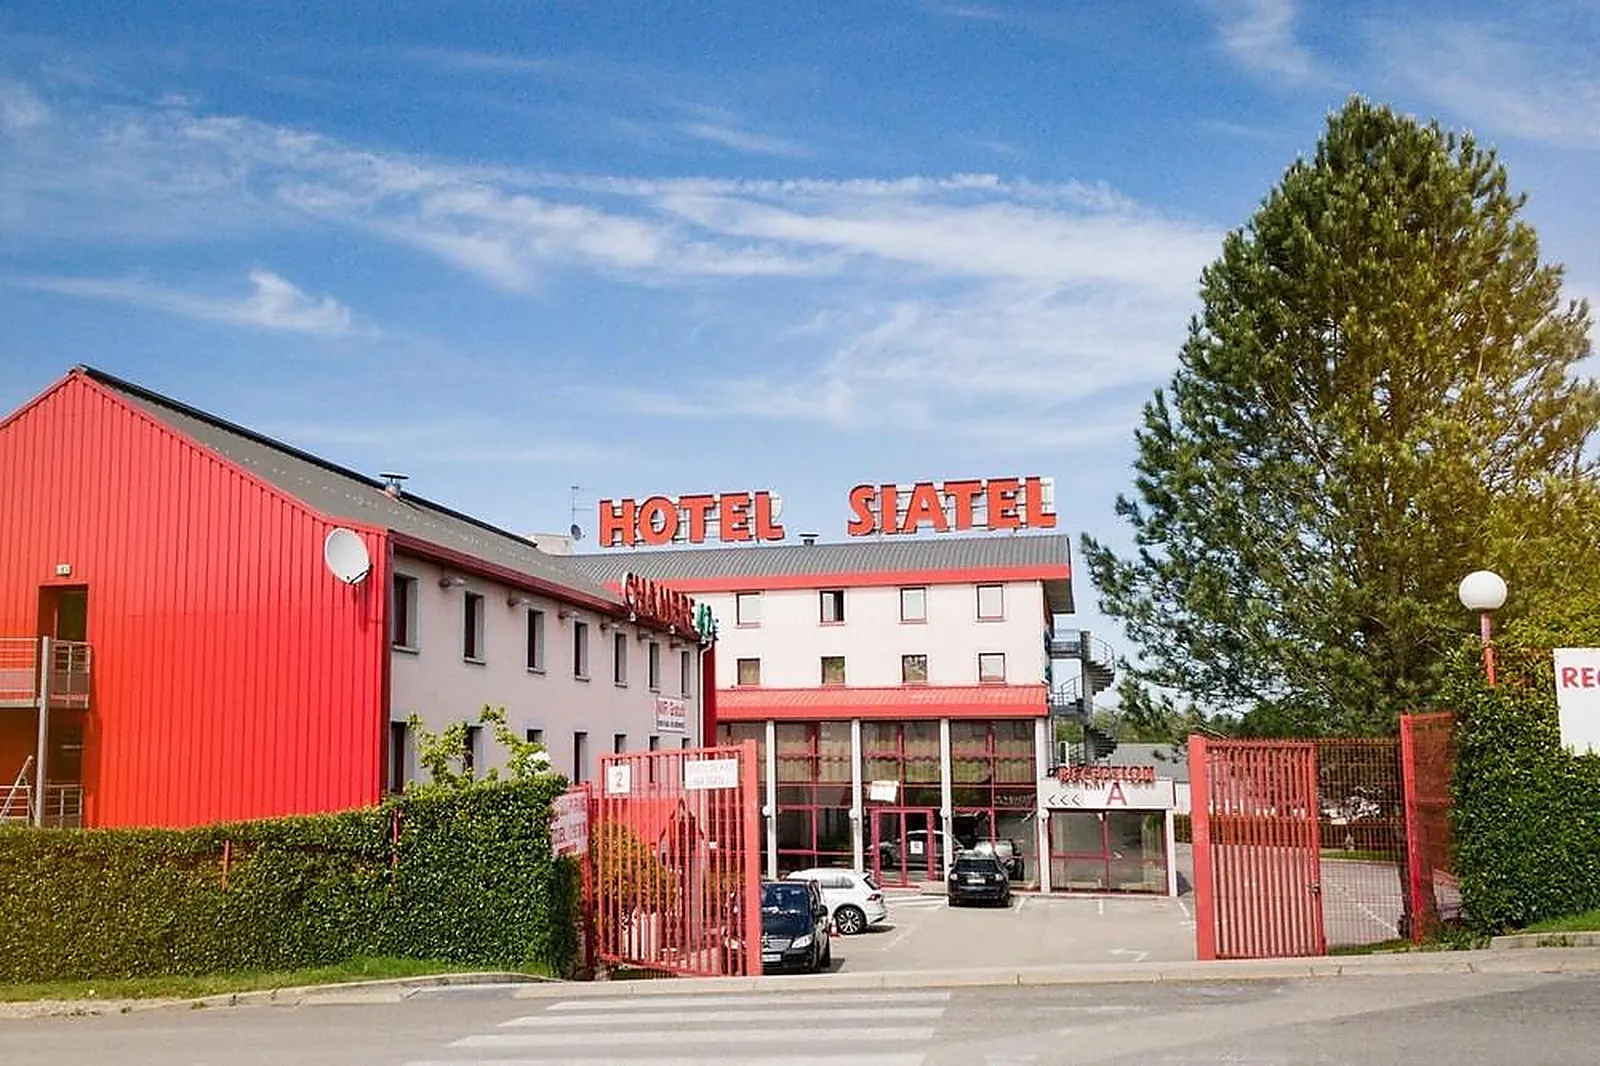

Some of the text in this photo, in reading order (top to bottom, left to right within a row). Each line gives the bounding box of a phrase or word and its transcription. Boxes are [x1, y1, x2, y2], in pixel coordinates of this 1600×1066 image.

[599, 476, 1057, 547] HOTEL SIATEL
[1561, 666, 1600, 689] RE
[616, 771, 624, 788] 2
